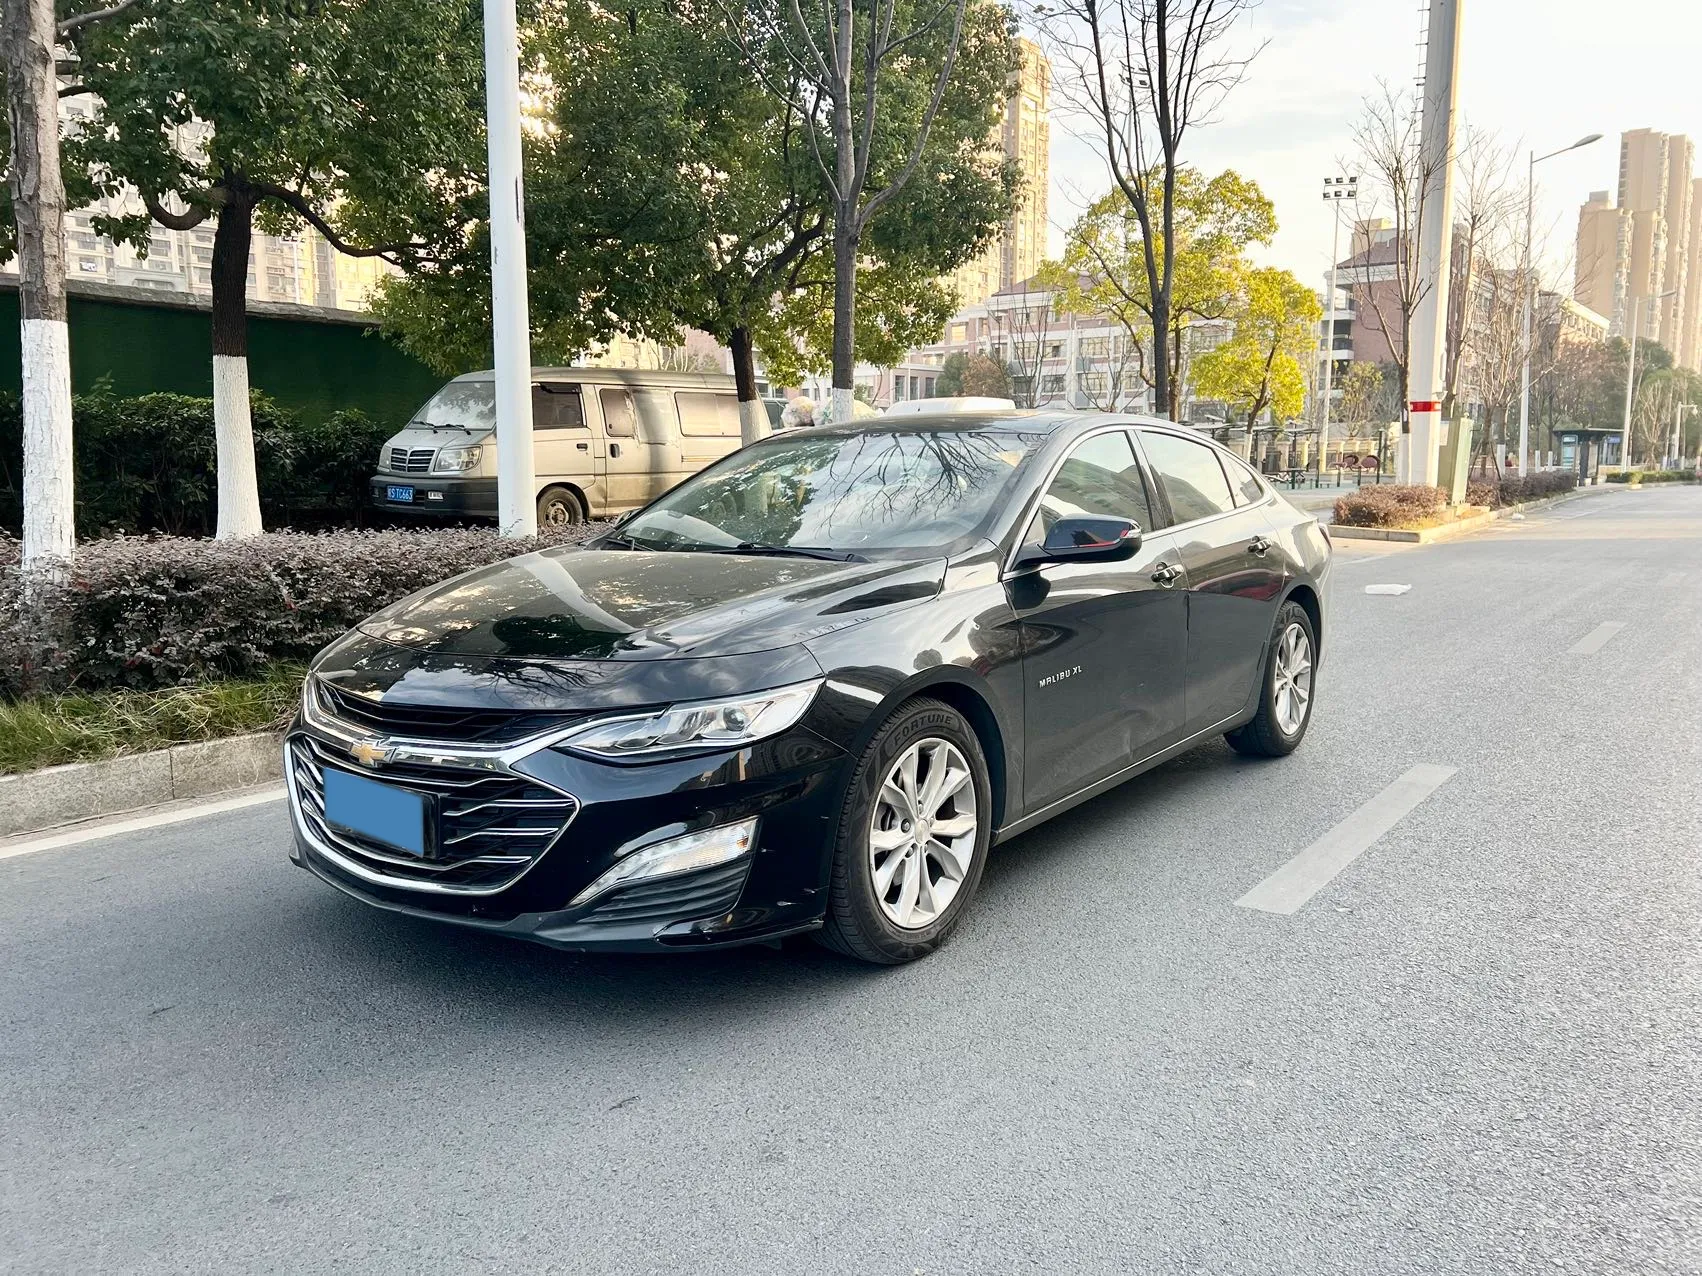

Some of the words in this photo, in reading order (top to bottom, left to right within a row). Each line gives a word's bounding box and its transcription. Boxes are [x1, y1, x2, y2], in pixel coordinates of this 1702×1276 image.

[1039, 669, 1071, 688] MALIBU
[1072, 665, 1082, 675] XL
[893, 713, 953, 745] FORTUNE
